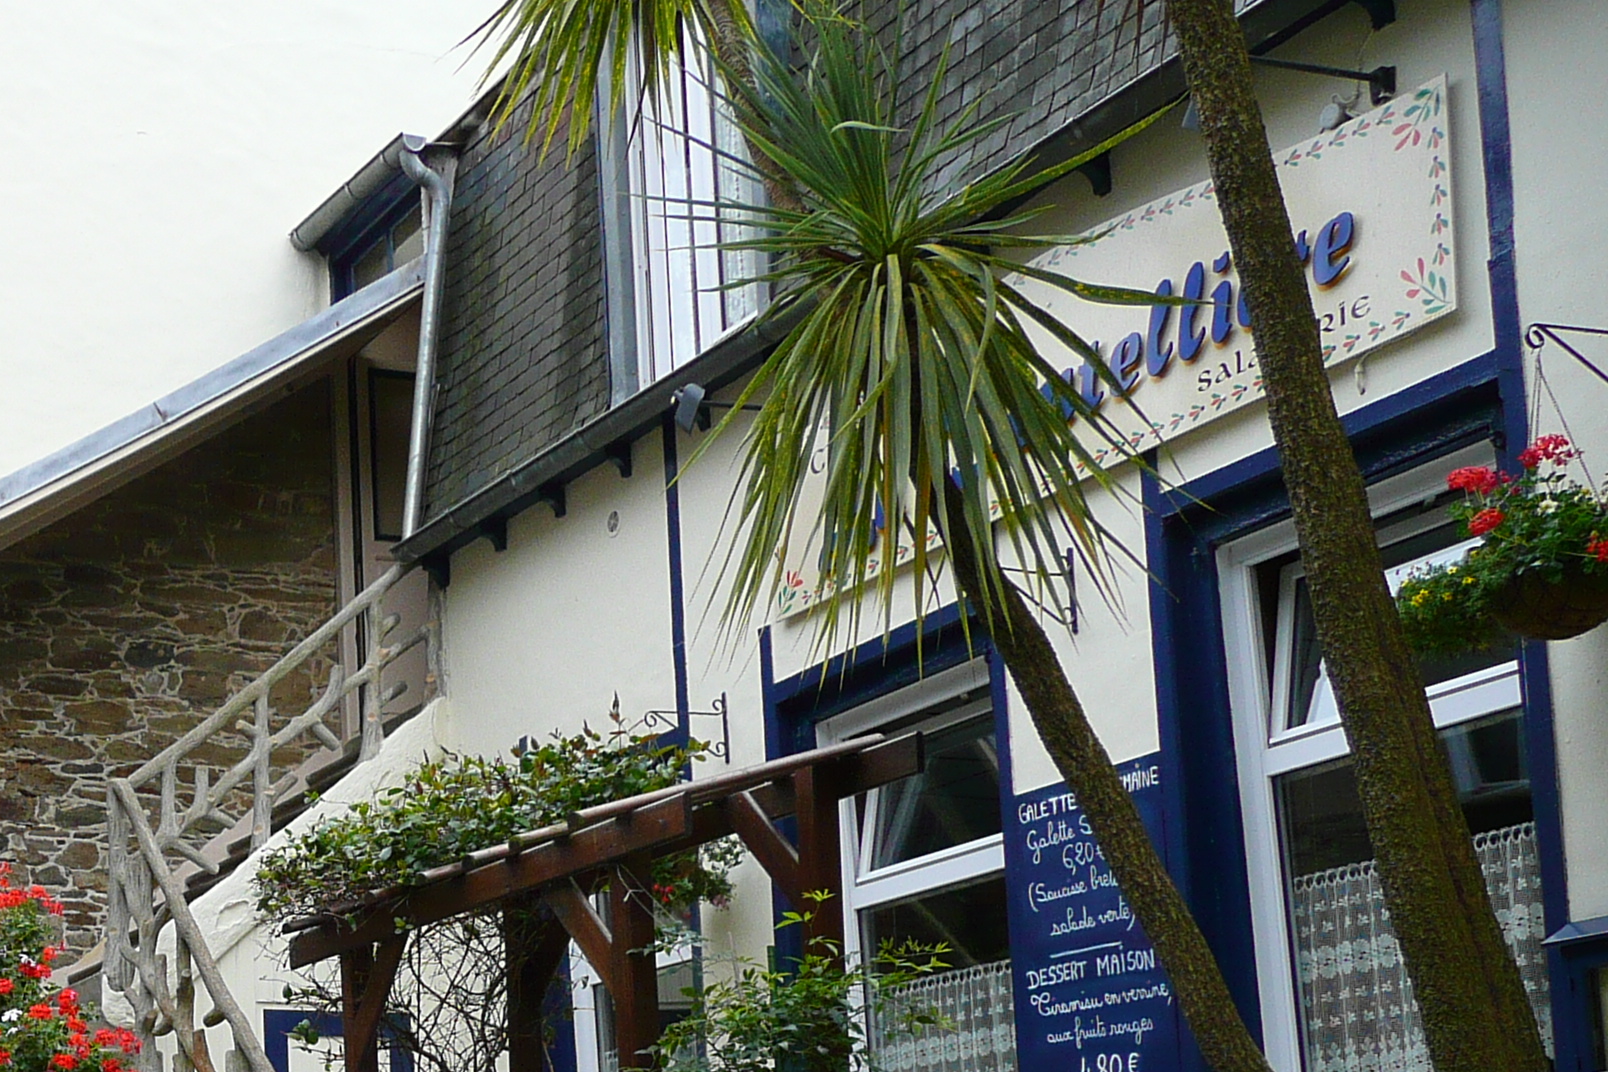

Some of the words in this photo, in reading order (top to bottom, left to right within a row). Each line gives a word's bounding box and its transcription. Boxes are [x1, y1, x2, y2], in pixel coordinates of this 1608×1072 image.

[1018, 793, 1078, 824] GALETTE
[1119, 763, 1159, 792] MAINE
[1026, 820, 1076, 864] Galette
[1050, 906, 1096, 936] salade
[1026, 961, 1087, 990] DESSERT
[1096, 945, 1155, 977] MAISON
[1030, 991, 1103, 1016] Tiramisu
[1104, 993, 1121, 1006] en
[1047, 1032, 1073, 1043] aux
[1074, 1015, 1106, 1049] fruits
[1108, 1017, 1153, 1044] rouges
